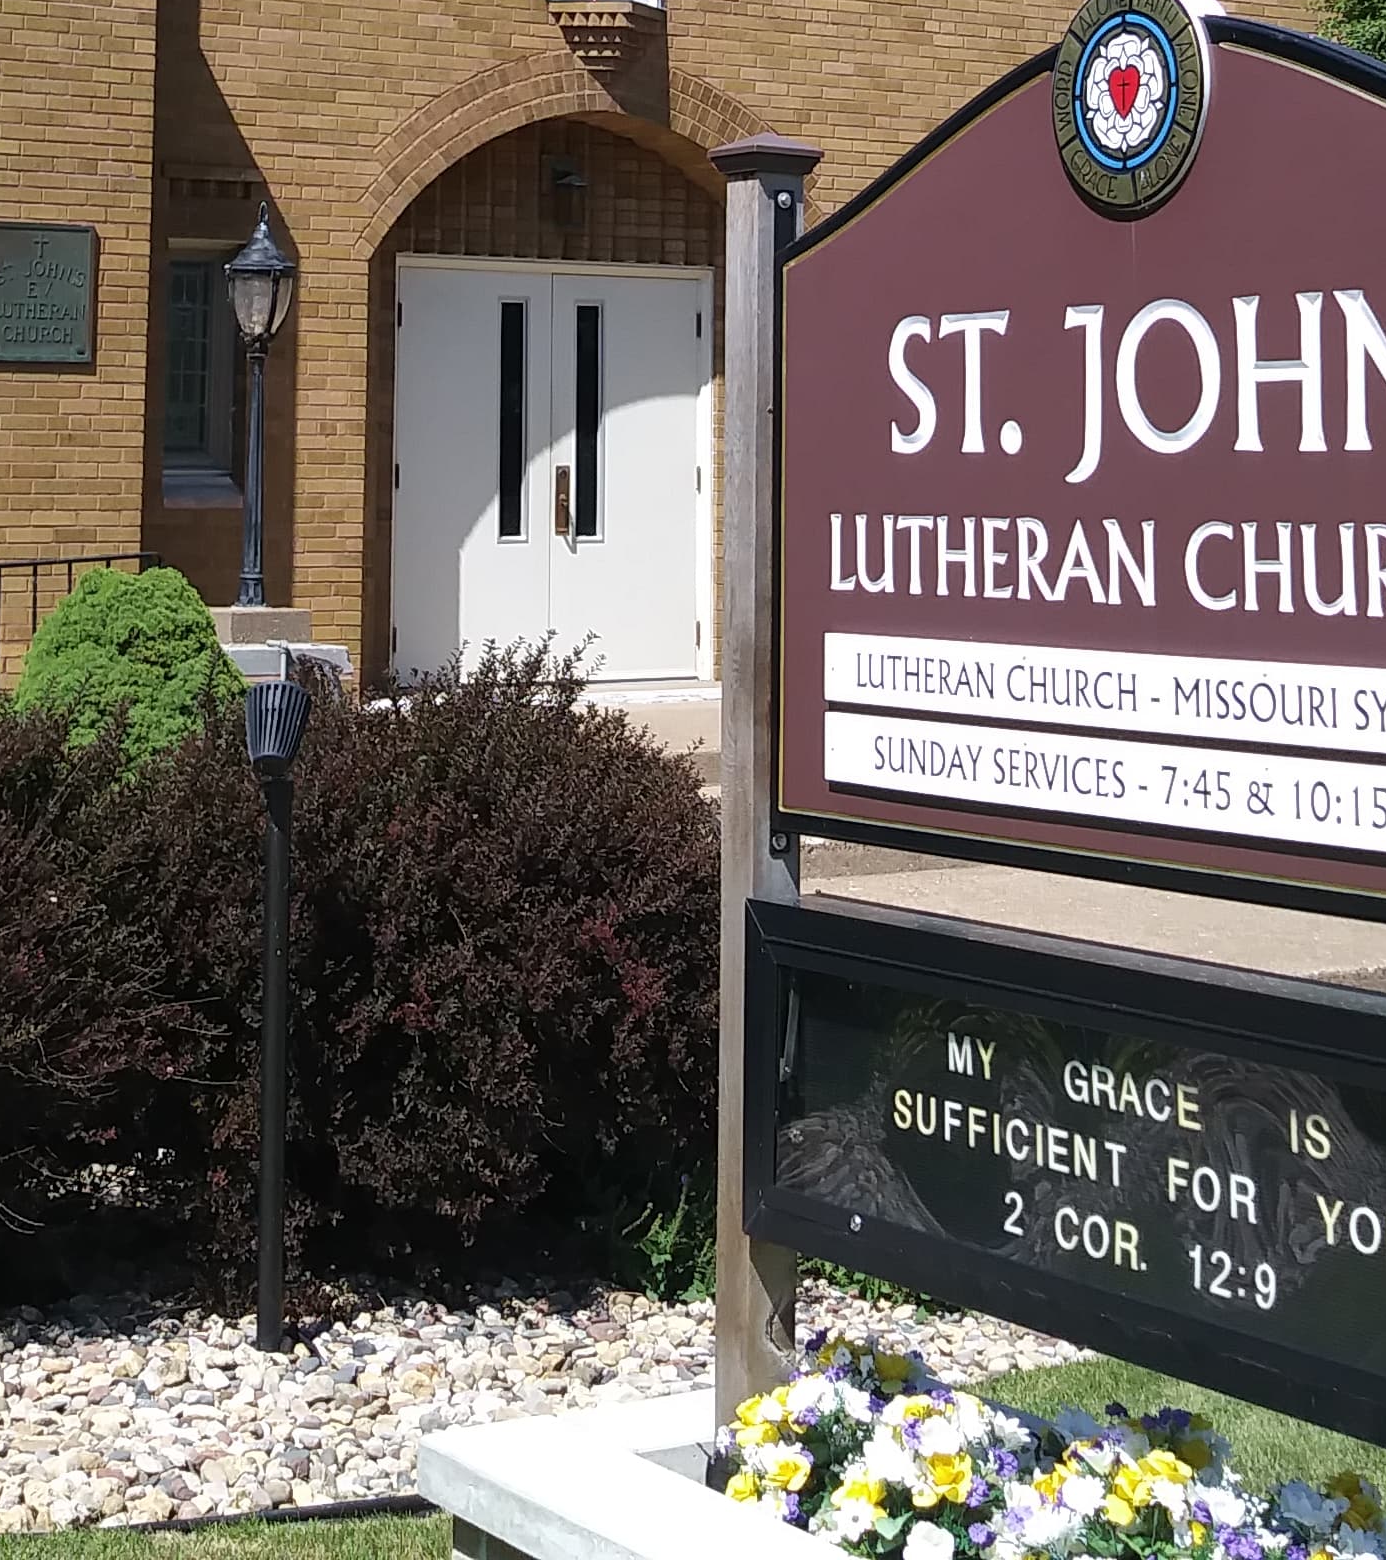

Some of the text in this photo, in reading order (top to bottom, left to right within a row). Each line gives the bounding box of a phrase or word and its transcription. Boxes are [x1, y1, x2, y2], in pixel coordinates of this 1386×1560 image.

[1054, 59, 1073, 133] WORD
[1175, 40, 1199, 128] ALONE
[1070, 134, 1187, 199] GRACE ALONE
[3, 324, 73, 344] CHURCH
[886, 309, 1023, 456] ST.
[829, 513, 1156, 607] LUTHERAN
[854, 652, 995, 701] LUTHERAN
[1005, 662, 1139, 712] CHURCH
[1172, 678, 1340, 729] MISSOURI
[872, 735, 983, 782] SUNDAY
[993, 745, 1126, 799] SERVICES
[1161, 765, 1233, 813] 7:45
[1247, 779, 1275, 816] &
[947, 1033, 1332, 1162] MY GRACE IS
[892, 1089, 1127, 1189] SUFFICIENT
[1167, 1158, 1257, 1225] FOR
[1003, 1191, 1277, 1311] 2 COR. 12:9
